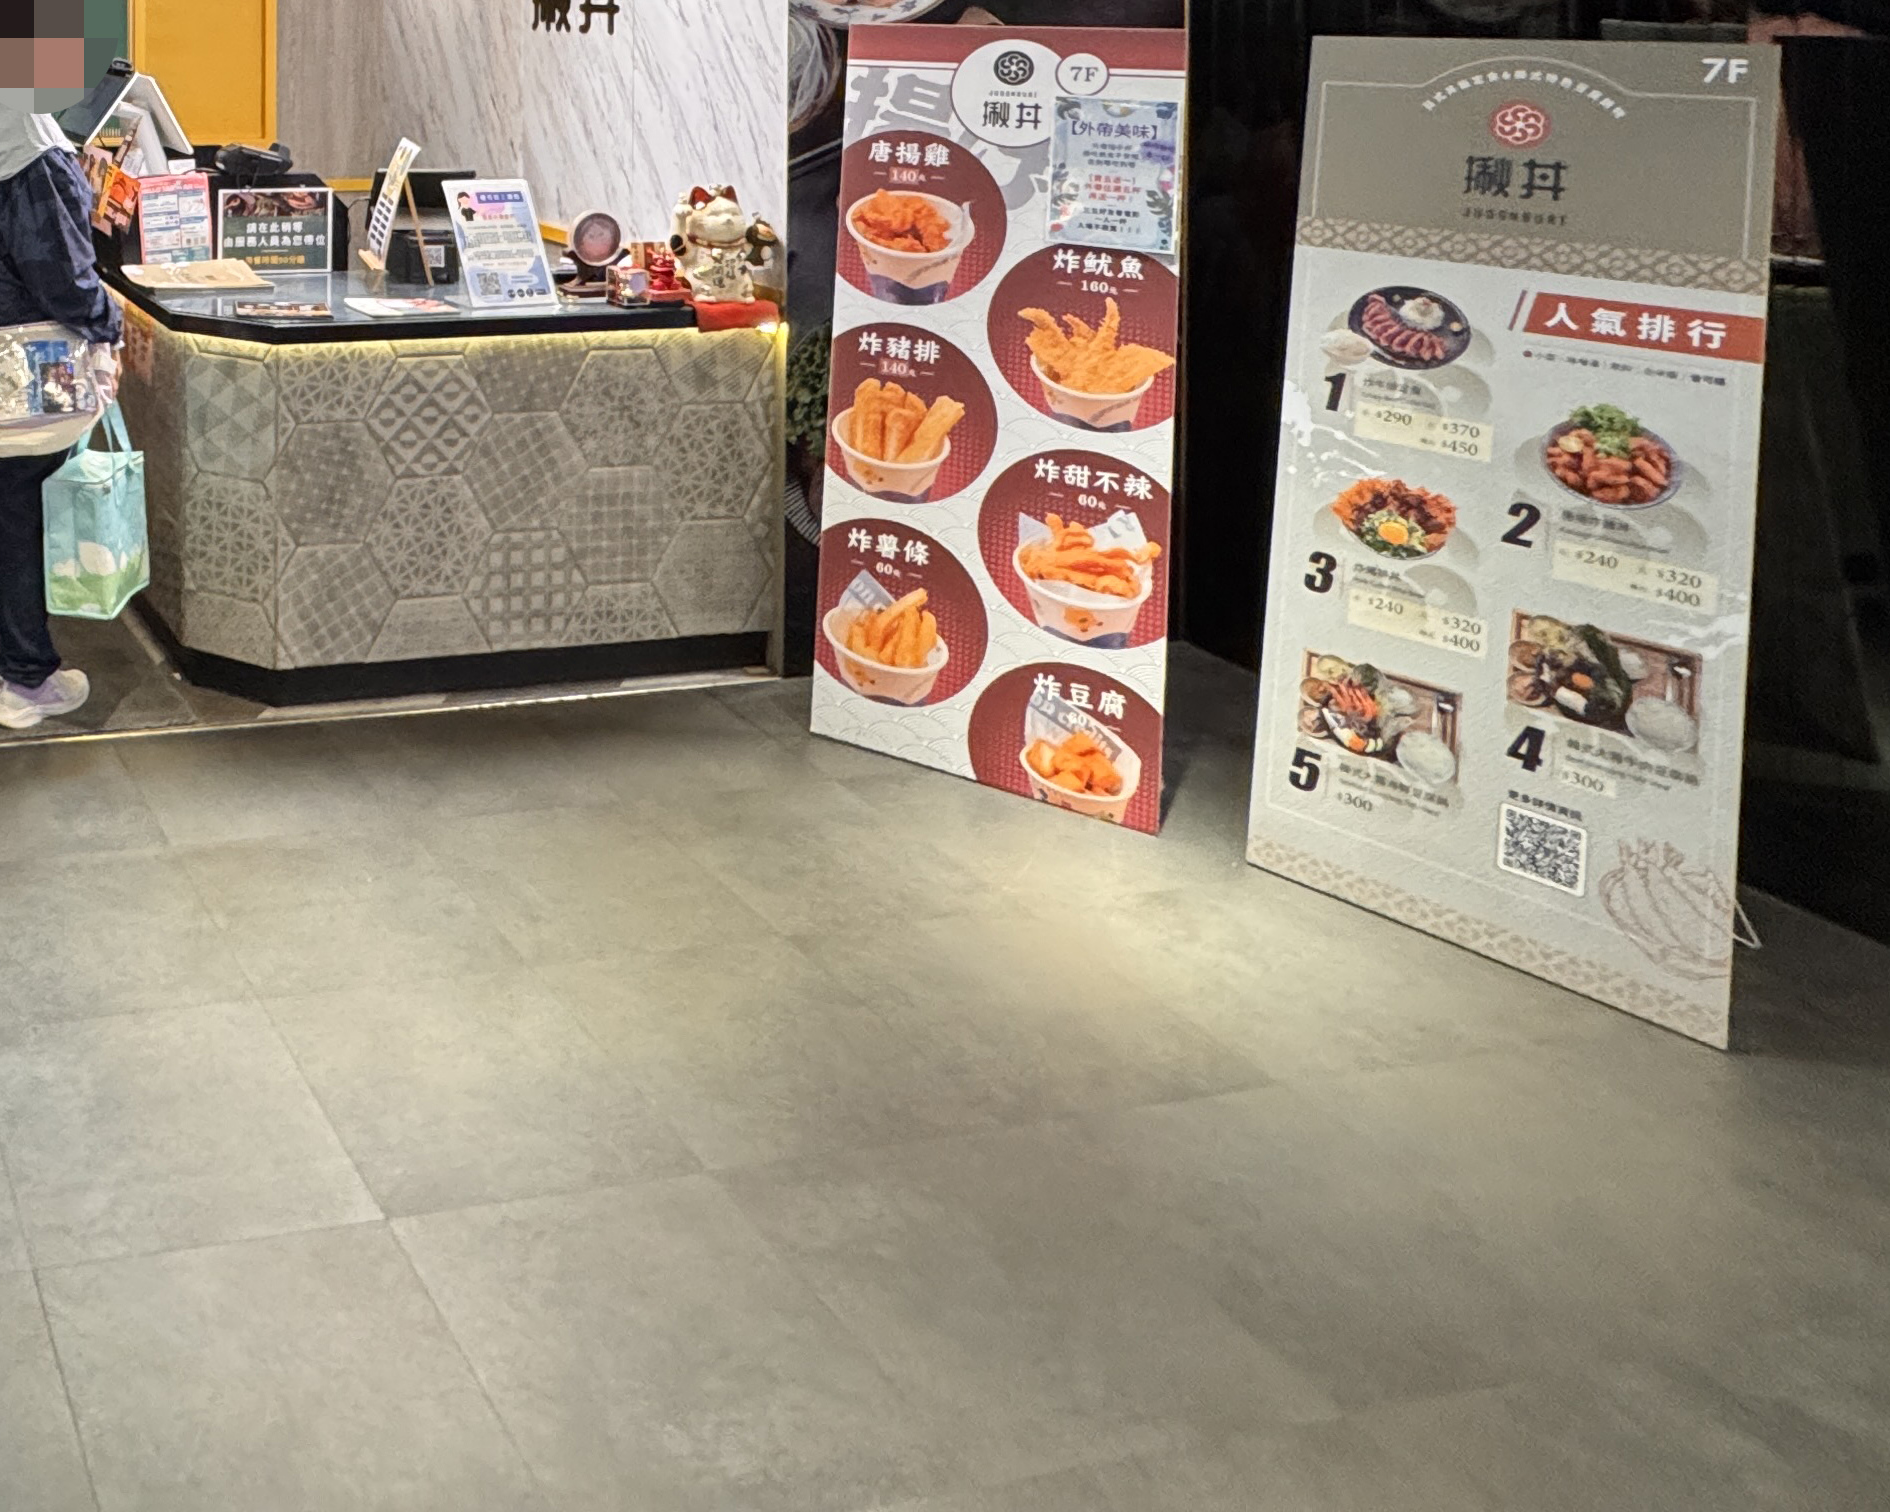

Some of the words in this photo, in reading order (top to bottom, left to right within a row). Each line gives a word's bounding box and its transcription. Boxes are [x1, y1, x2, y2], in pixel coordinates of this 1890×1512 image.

[1070, 66, 1099, 82] 7F
[1701, 57, 1749, 85] 7F
[868, 140, 951, 168] 唐揚雞
[1052, 249, 1146, 280] 炸魷魚
[1544, 301, 1727, 349] 人氣排行
[858, 331, 941, 364] 炸豬排
[1324, 372, 1347, 412] 1
[1034, 458, 1153, 500] 炸甜不辣
[1501, 501, 1541, 548] 2
[847, 527, 930, 567] 炸薯條
[1304, 551, 1338, 594] 3
[1034, 672, 1128, 720] 炸豆腐
[1288, 746, 1322, 792] 5
[1506, 725, 1545, 773] 4
